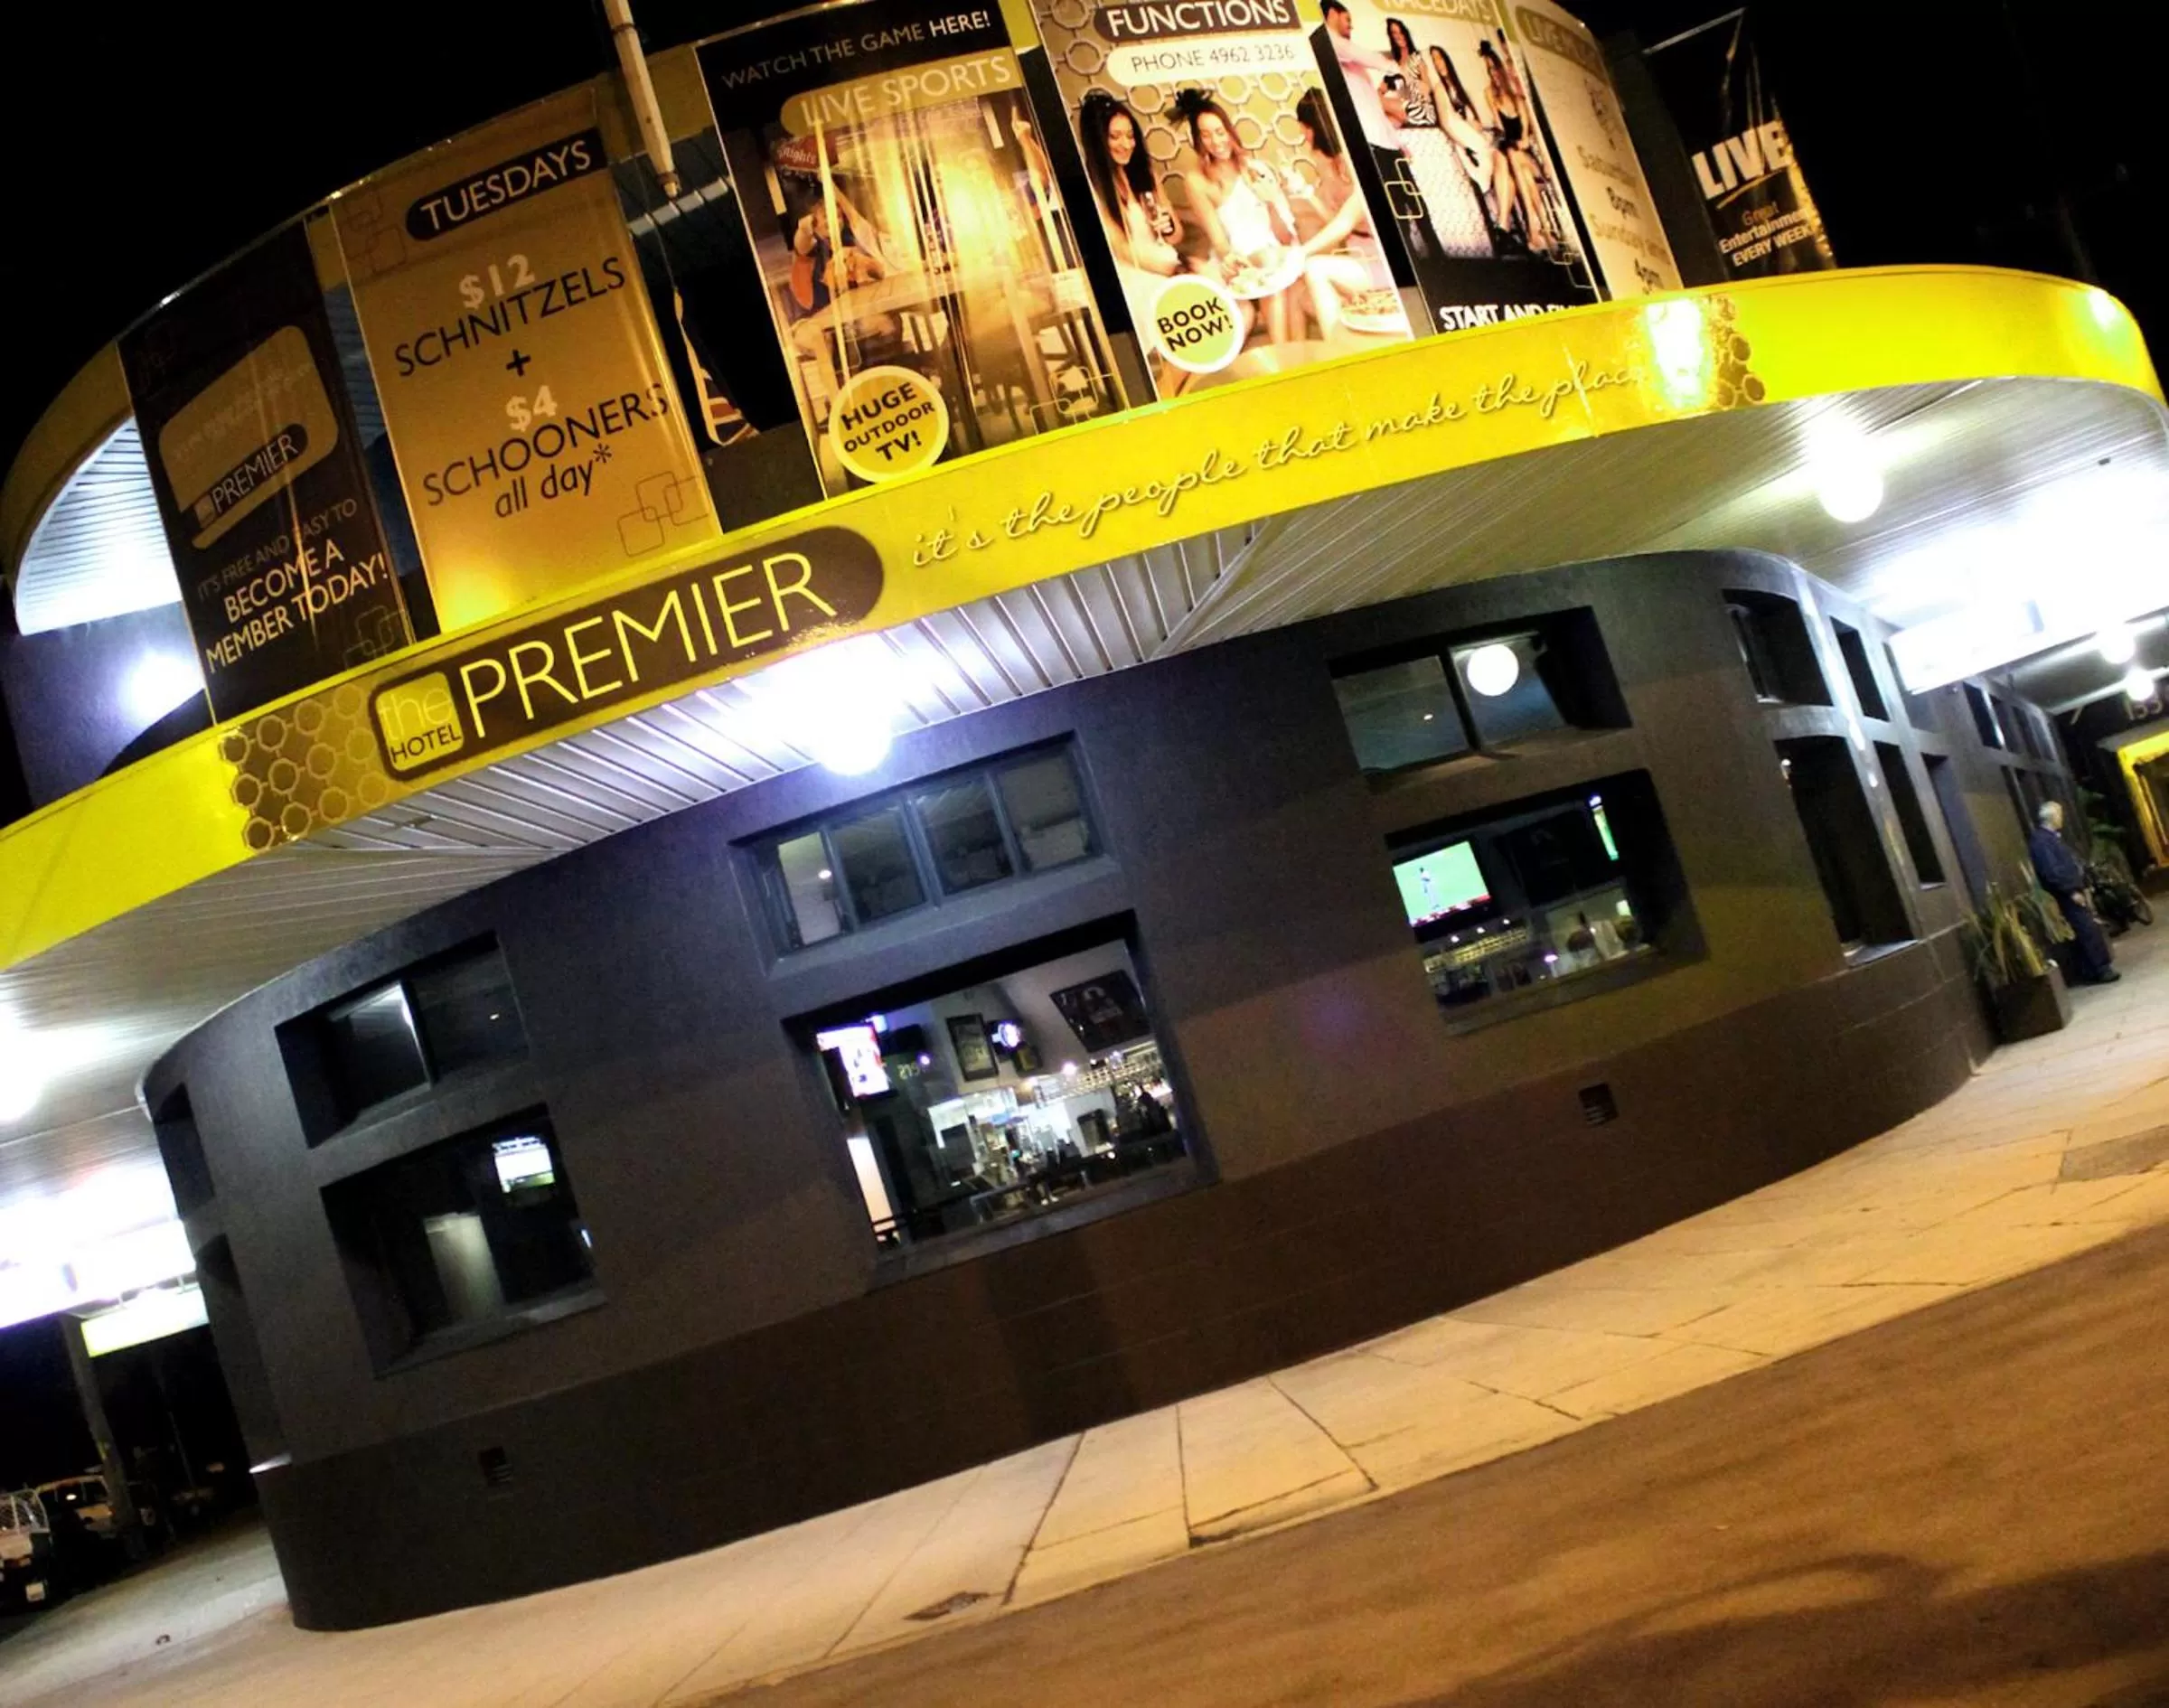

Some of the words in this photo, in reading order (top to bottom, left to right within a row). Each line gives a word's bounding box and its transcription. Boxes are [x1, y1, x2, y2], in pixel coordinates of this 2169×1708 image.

[1106, 0, 1291, 37] FUNCTIONS
[720, 51, 807, 90] WATCH
[809, 39, 856, 65] THE
[860, 23, 925, 52] GAME
[928, 10, 992, 38] HERE!
[1131, 50, 1206, 73] PHONE
[1209, 46, 1251, 64] 4962
[1257, 44, 1296, 61] 3236
[799, 86, 875, 128] LIVE
[881, 56, 1011, 107] SPORTS
[421, 139, 593, 232] TUESDAYS
[1691, 118, 1794, 201] LIVE
[1719, 206, 1813, 254] Entertainme
[1731, 237, 1773, 267] EVERY
[458, 254, 537, 311] $12
[394, 257, 626, 377] SCHNITZELS
[1157, 296, 1224, 334] BOOK
[1166, 314, 1234, 352] NOW!
[1438, 304, 1500, 332] START
[505, 385, 559, 433] $4
[840, 381, 917, 431] HUGE
[843, 401, 935, 453] OUTDOOR
[423, 382, 669, 507] SCHOONERS
[875, 429, 922, 462] TV!
[912, 504, 993, 568] it's
[1000, 492, 1082, 540] the
[1079, 448, 1247, 539] people
[1252, 425, 1356, 472] that
[1365, 392, 1468, 443] make
[1472, 375, 1545, 415] the
[211, 434, 299, 514] PREMIER
[494, 479, 529, 519] all
[221, 553, 254, 587] FREE
[256, 535, 290, 563] AND
[295, 510, 330, 546] ASY
[331, 498, 358, 522] TO
[224, 546, 323, 624] BECOME
[324, 539, 344, 569] A
[205, 605, 295, 675] MEMBER
[290, 551, 389, 622] TODAY!
[459, 551, 838, 739] PREMIER
[378, 687, 454, 741] the
[390, 723, 463, 764] HOTEL
